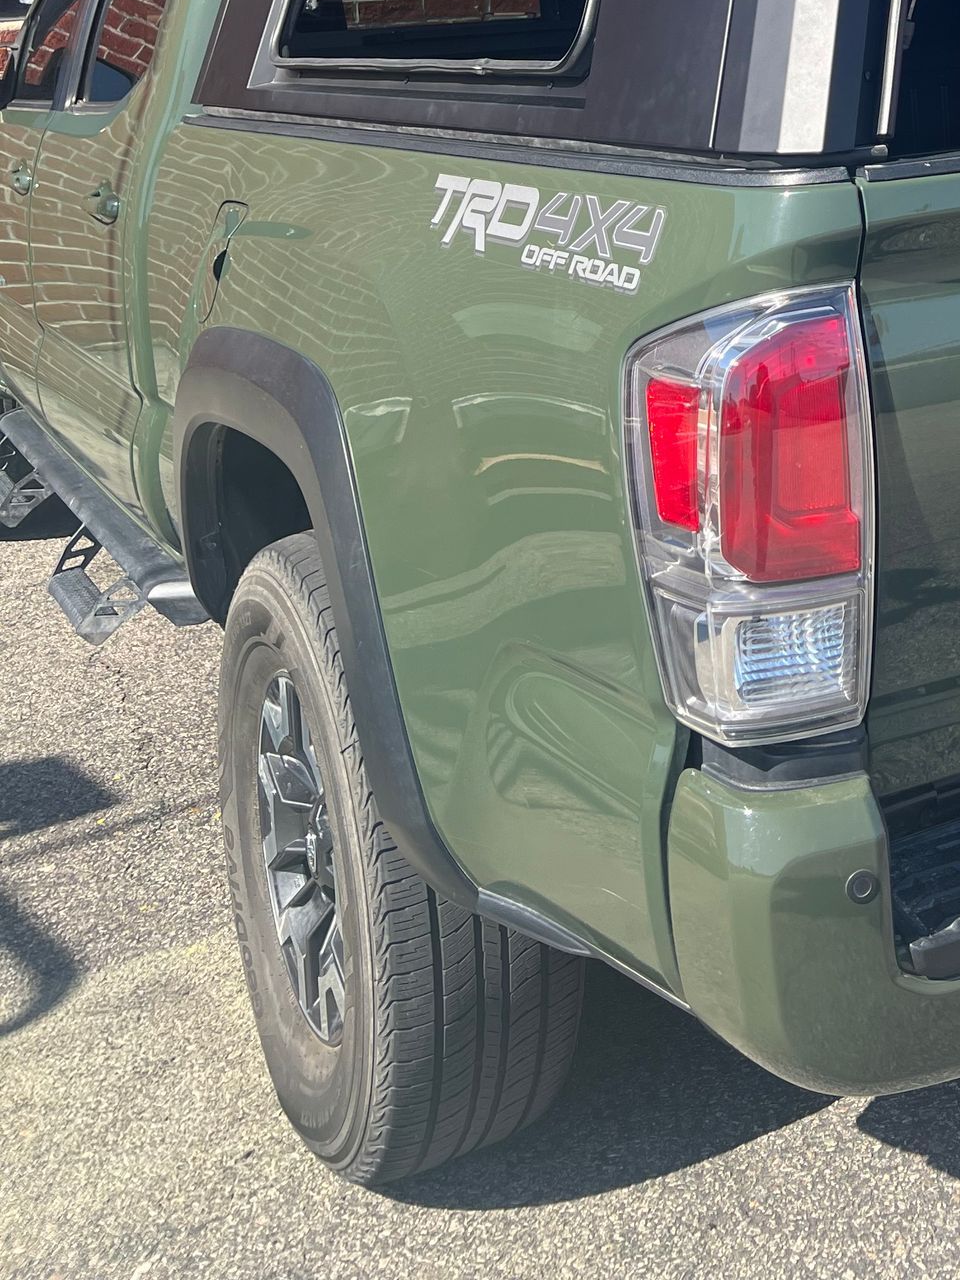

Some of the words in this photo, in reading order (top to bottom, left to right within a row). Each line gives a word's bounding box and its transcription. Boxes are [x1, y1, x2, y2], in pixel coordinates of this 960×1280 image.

[431, 173, 540, 254] TRD
[534, 192, 666, 265] 4X4
[520, 244, 570, 270] OFF
[568, 254, 641, 291] ROAD
